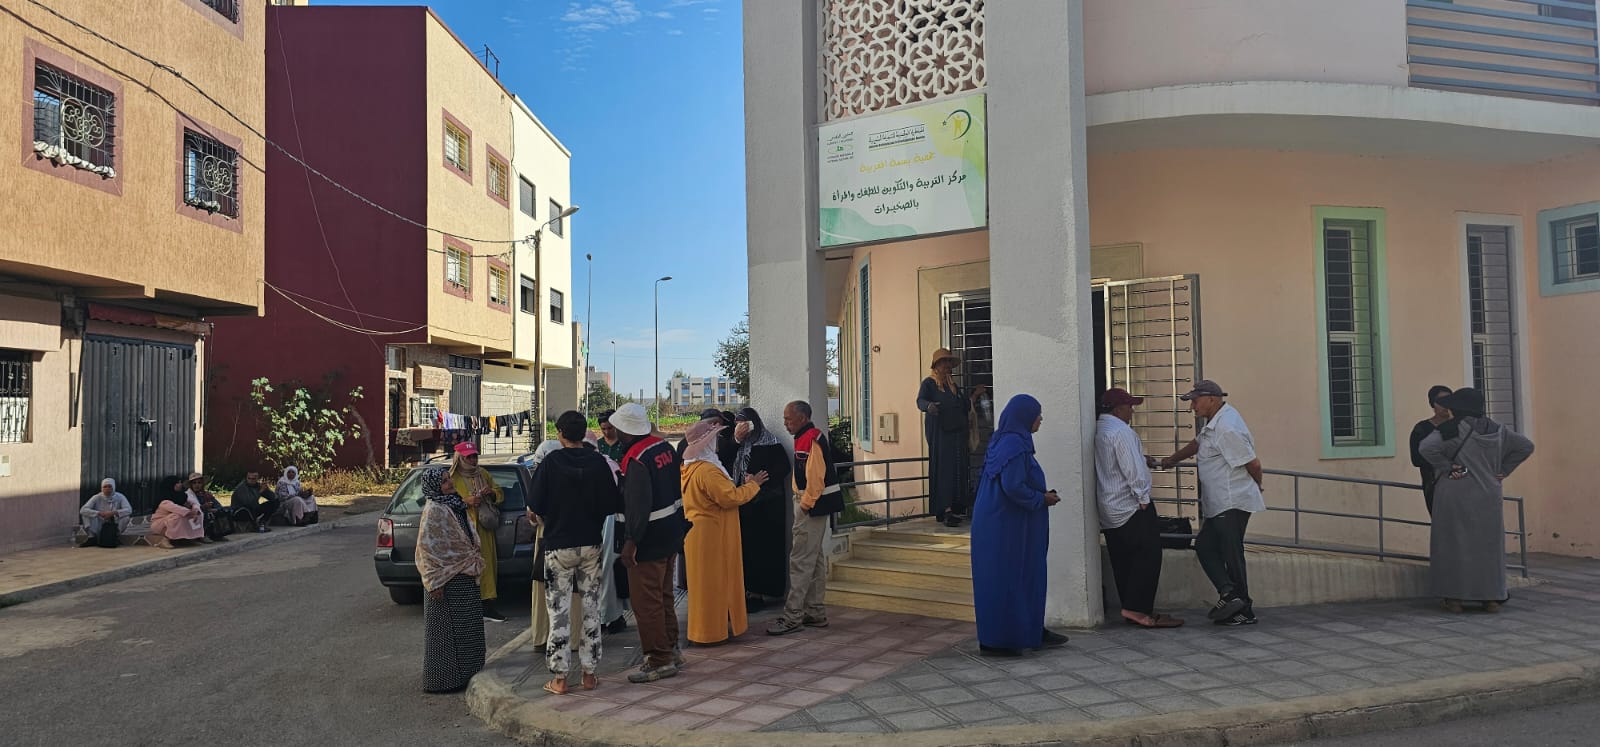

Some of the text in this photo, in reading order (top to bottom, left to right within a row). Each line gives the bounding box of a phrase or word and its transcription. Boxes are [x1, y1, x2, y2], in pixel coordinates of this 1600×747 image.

[832, 169, 967, 202] مركز التربية والتكوين للطفل والمرأة
[873, 199, 919, 214] بالصخيرات
